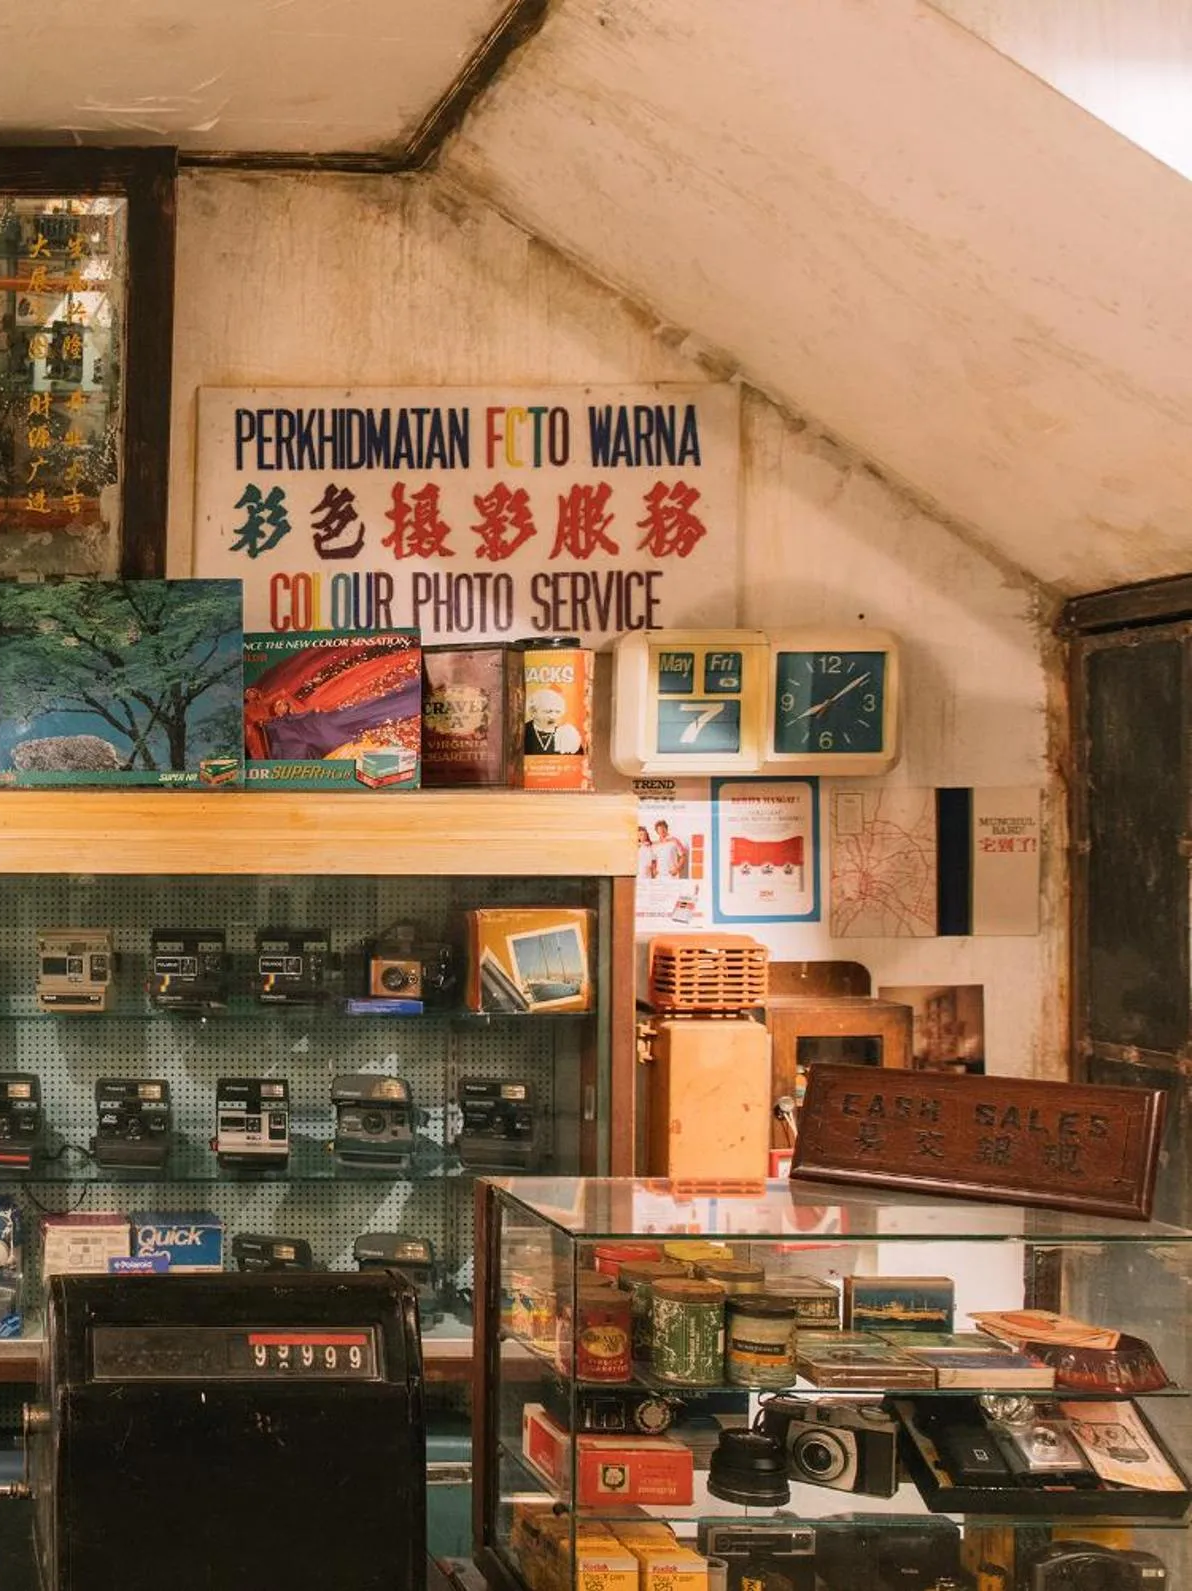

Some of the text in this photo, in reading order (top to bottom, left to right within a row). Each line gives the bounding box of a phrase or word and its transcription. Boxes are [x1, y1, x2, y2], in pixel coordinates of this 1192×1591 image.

[235, 407, 470, 471] PERKHIDMATAN
[589, 404, 702, 469] WARNA
[270, 570, 664, 634] COLOUR PHOTO SERVICE
[265, 641, 283, 650] THE
[286, 640, 312, 649] NEW
[312, 638, 349, 648] COLOR
[659, 653, 692, 678] May
[710, 654, 734, 672] Fri
[819, 655, 842, 674] 12
[524, 665, 575, 684] ACKS
[781, 694, 794, 712] 9
[863, 694, 876, 712] 3
[679, 702, 725, 744] 7
[819, 730, 833, 749] 6
[158, 773, 186, 782] SUPER
[632, 779, 676, 790] TREND
[842, 1093, 1109, 1139] CASH SALES
[137, 1225, 203, 1247] Quick
[119, 1260, 153, 1269] Polaroid
[583, 1563, 608, 1572] Kodak
[653, 1565, 678, 1573] Kodak
